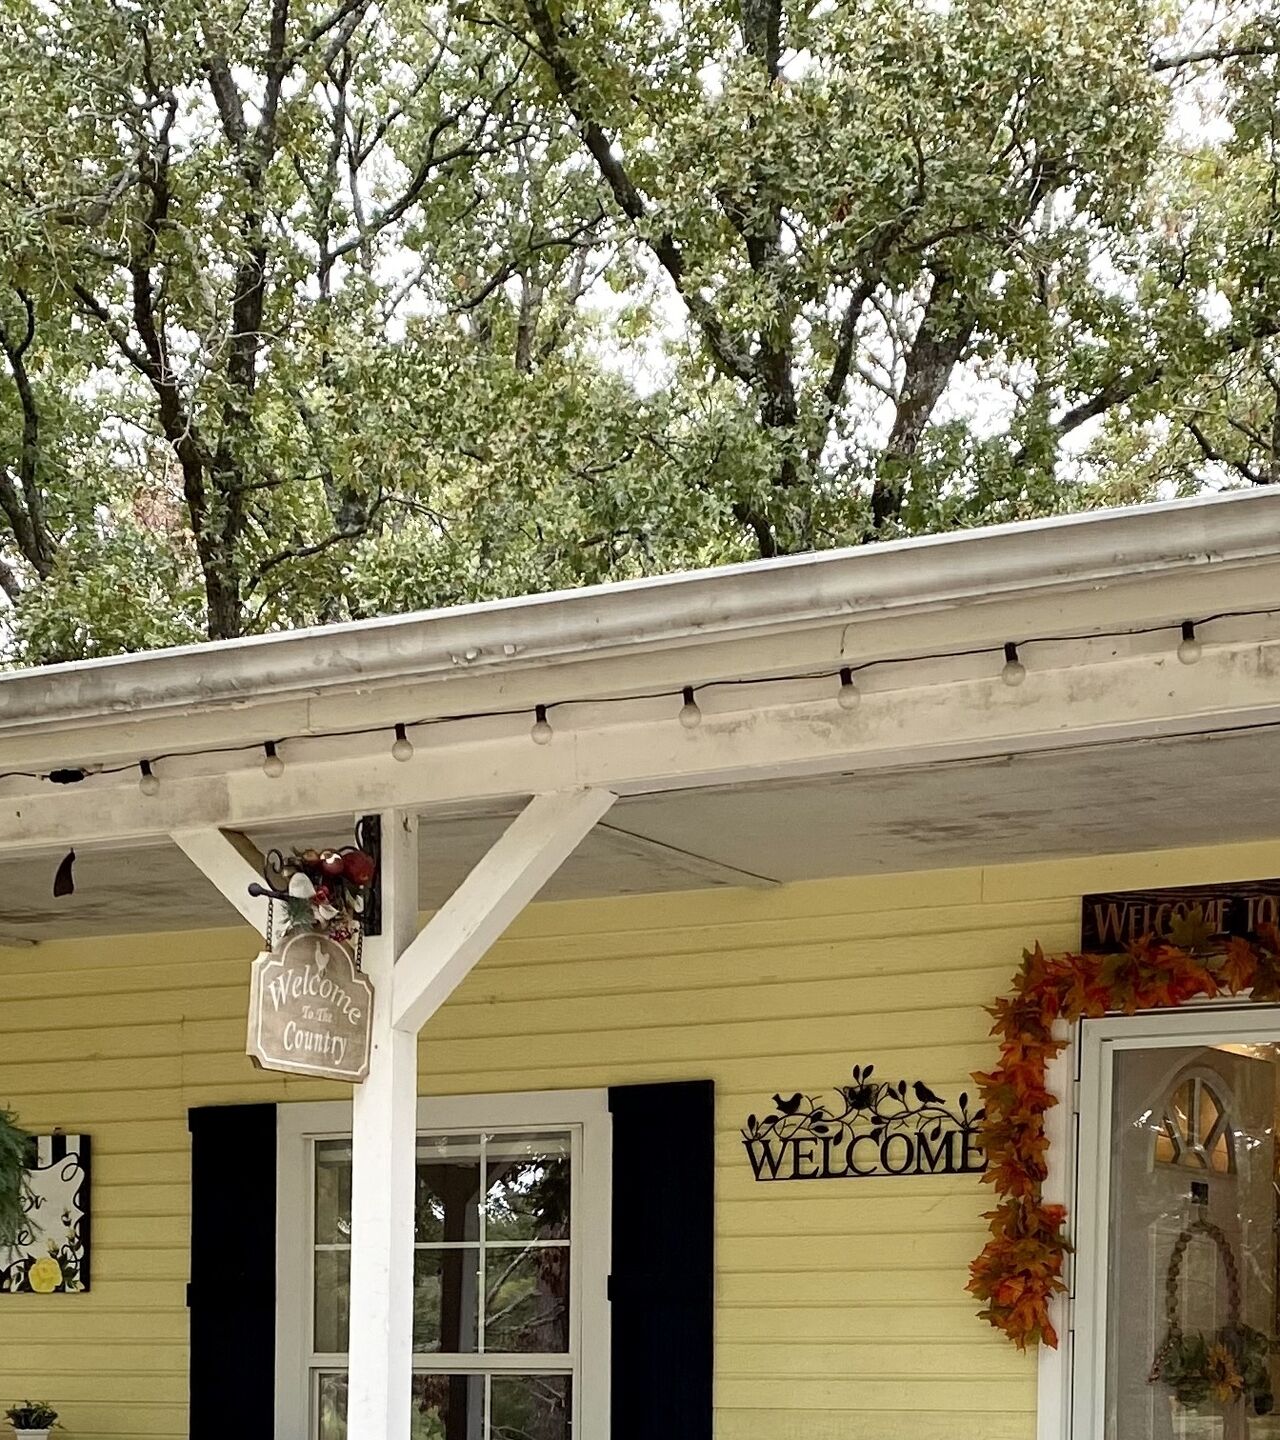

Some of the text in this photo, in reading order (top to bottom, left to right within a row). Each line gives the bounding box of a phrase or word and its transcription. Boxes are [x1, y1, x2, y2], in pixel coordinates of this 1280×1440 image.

[1243, 895, 1280, 932] TO
[270, 964, 362, 1025] Welcome
[302, 1005, 315, 1020] To
[283, 1021, 348, 1065] Country
[742, 1129, 989, 1182] WELCOME
